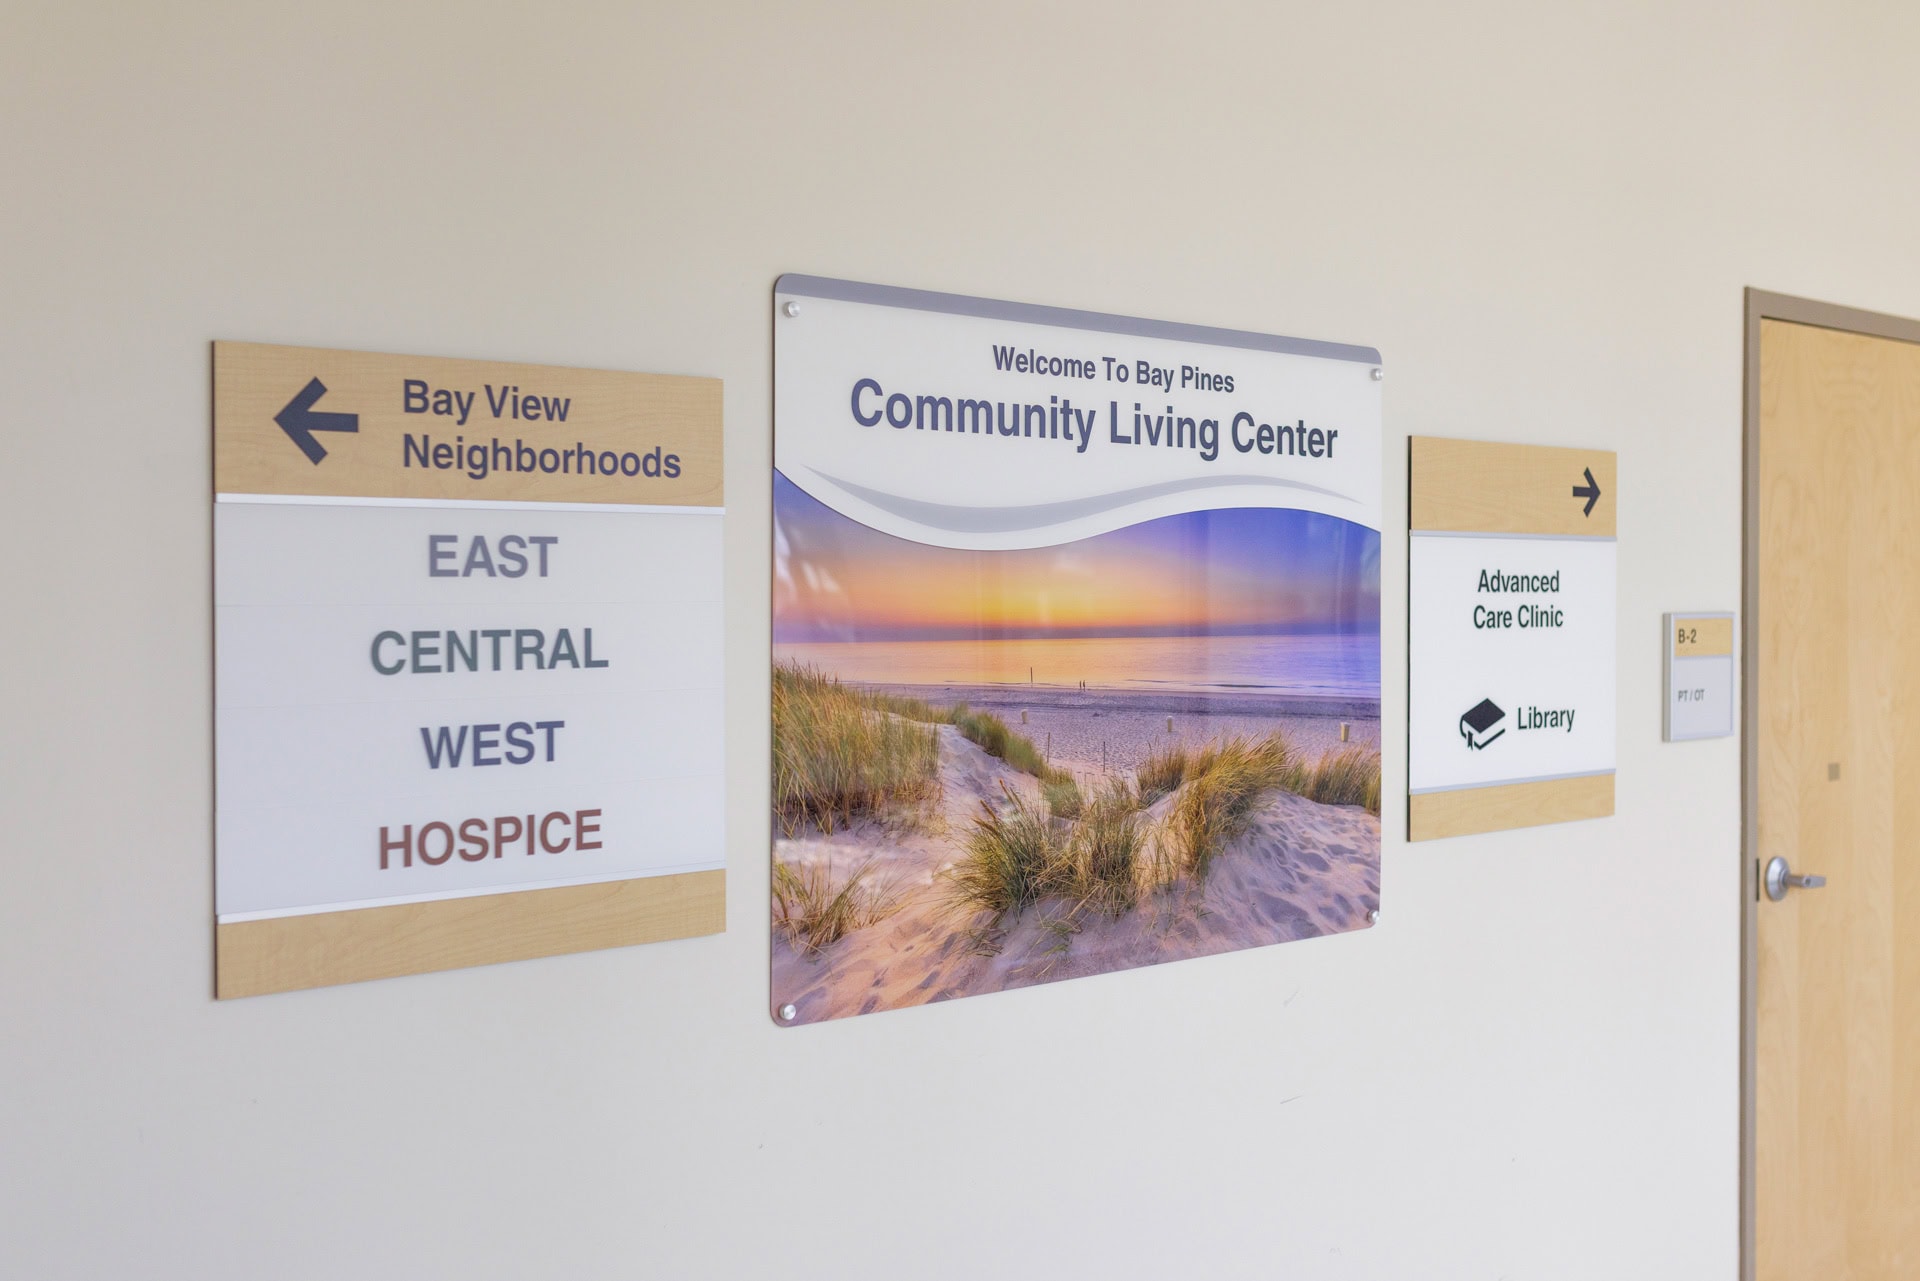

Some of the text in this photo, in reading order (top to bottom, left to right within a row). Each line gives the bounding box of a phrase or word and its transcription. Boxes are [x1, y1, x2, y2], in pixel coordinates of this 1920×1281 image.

[992, 345, 1235, 393] Welcome To Bay Pines
[403, 379, 571, 425] Bay View
[850, 377, 1338, 462] Community Living Center
[403, 433, 681, 480] Neighborhoods
[428, 534, 558, 578] EAST
[1477, 569, 1560, 593] Advanced
[1473, 604, 1564, 629] Care Clinic
[1678, 628, 1697, 644] B-2
[370, 628, 609, 676] CENTRAL
[1517, 707, 1575, 733] Library
[420, 720, 565, 769] WEST
[379, 808, 603, 869] HOSPICE
